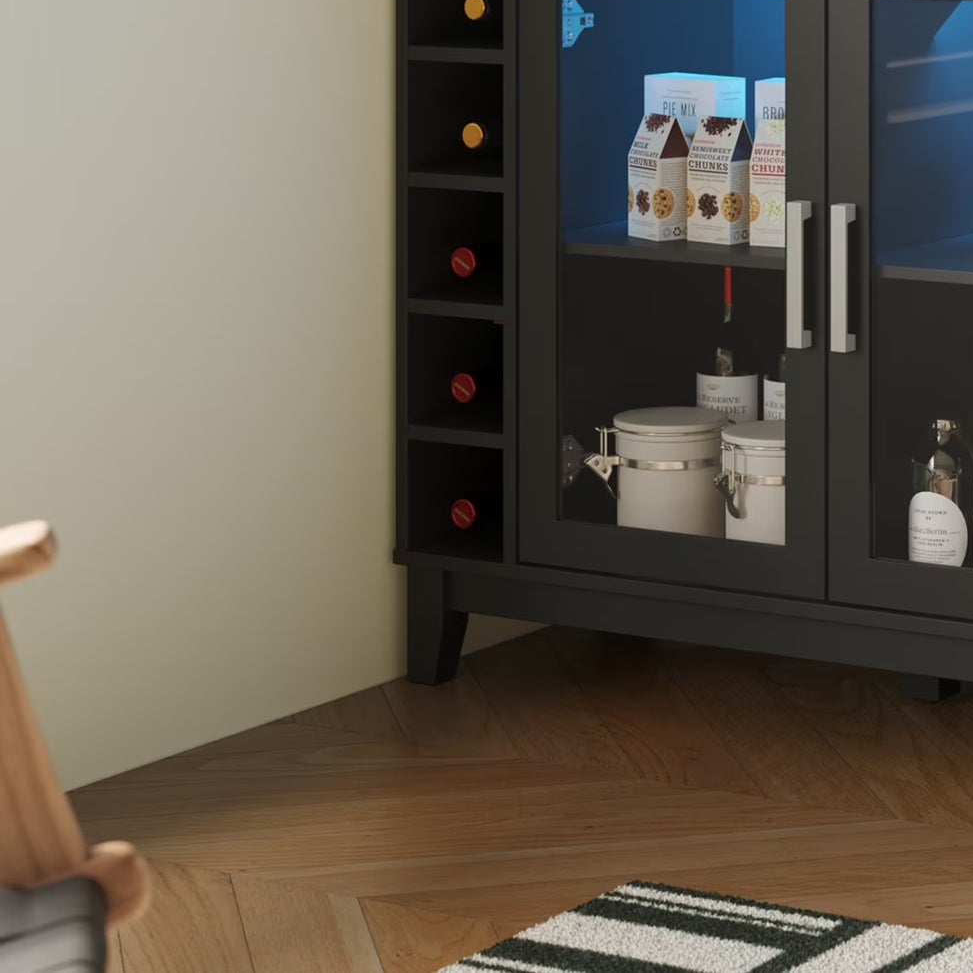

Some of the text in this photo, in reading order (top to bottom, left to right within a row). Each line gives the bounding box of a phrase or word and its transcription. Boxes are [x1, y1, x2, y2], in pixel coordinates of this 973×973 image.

[662, 101, 696, 117] PIE MIX
[634, 140, 649, 149] MILK
[630, 148, 660, 159] CHOCOLATE
[692, 145, 732, 155] SEMISWEET
[629, 156, 658, 168] CHUNKS
[689, 152, 730, 162] CHOCOLATE
[688, 160, 729, 172] CHUNKS
[751, 164, 785, 174] CHUN
